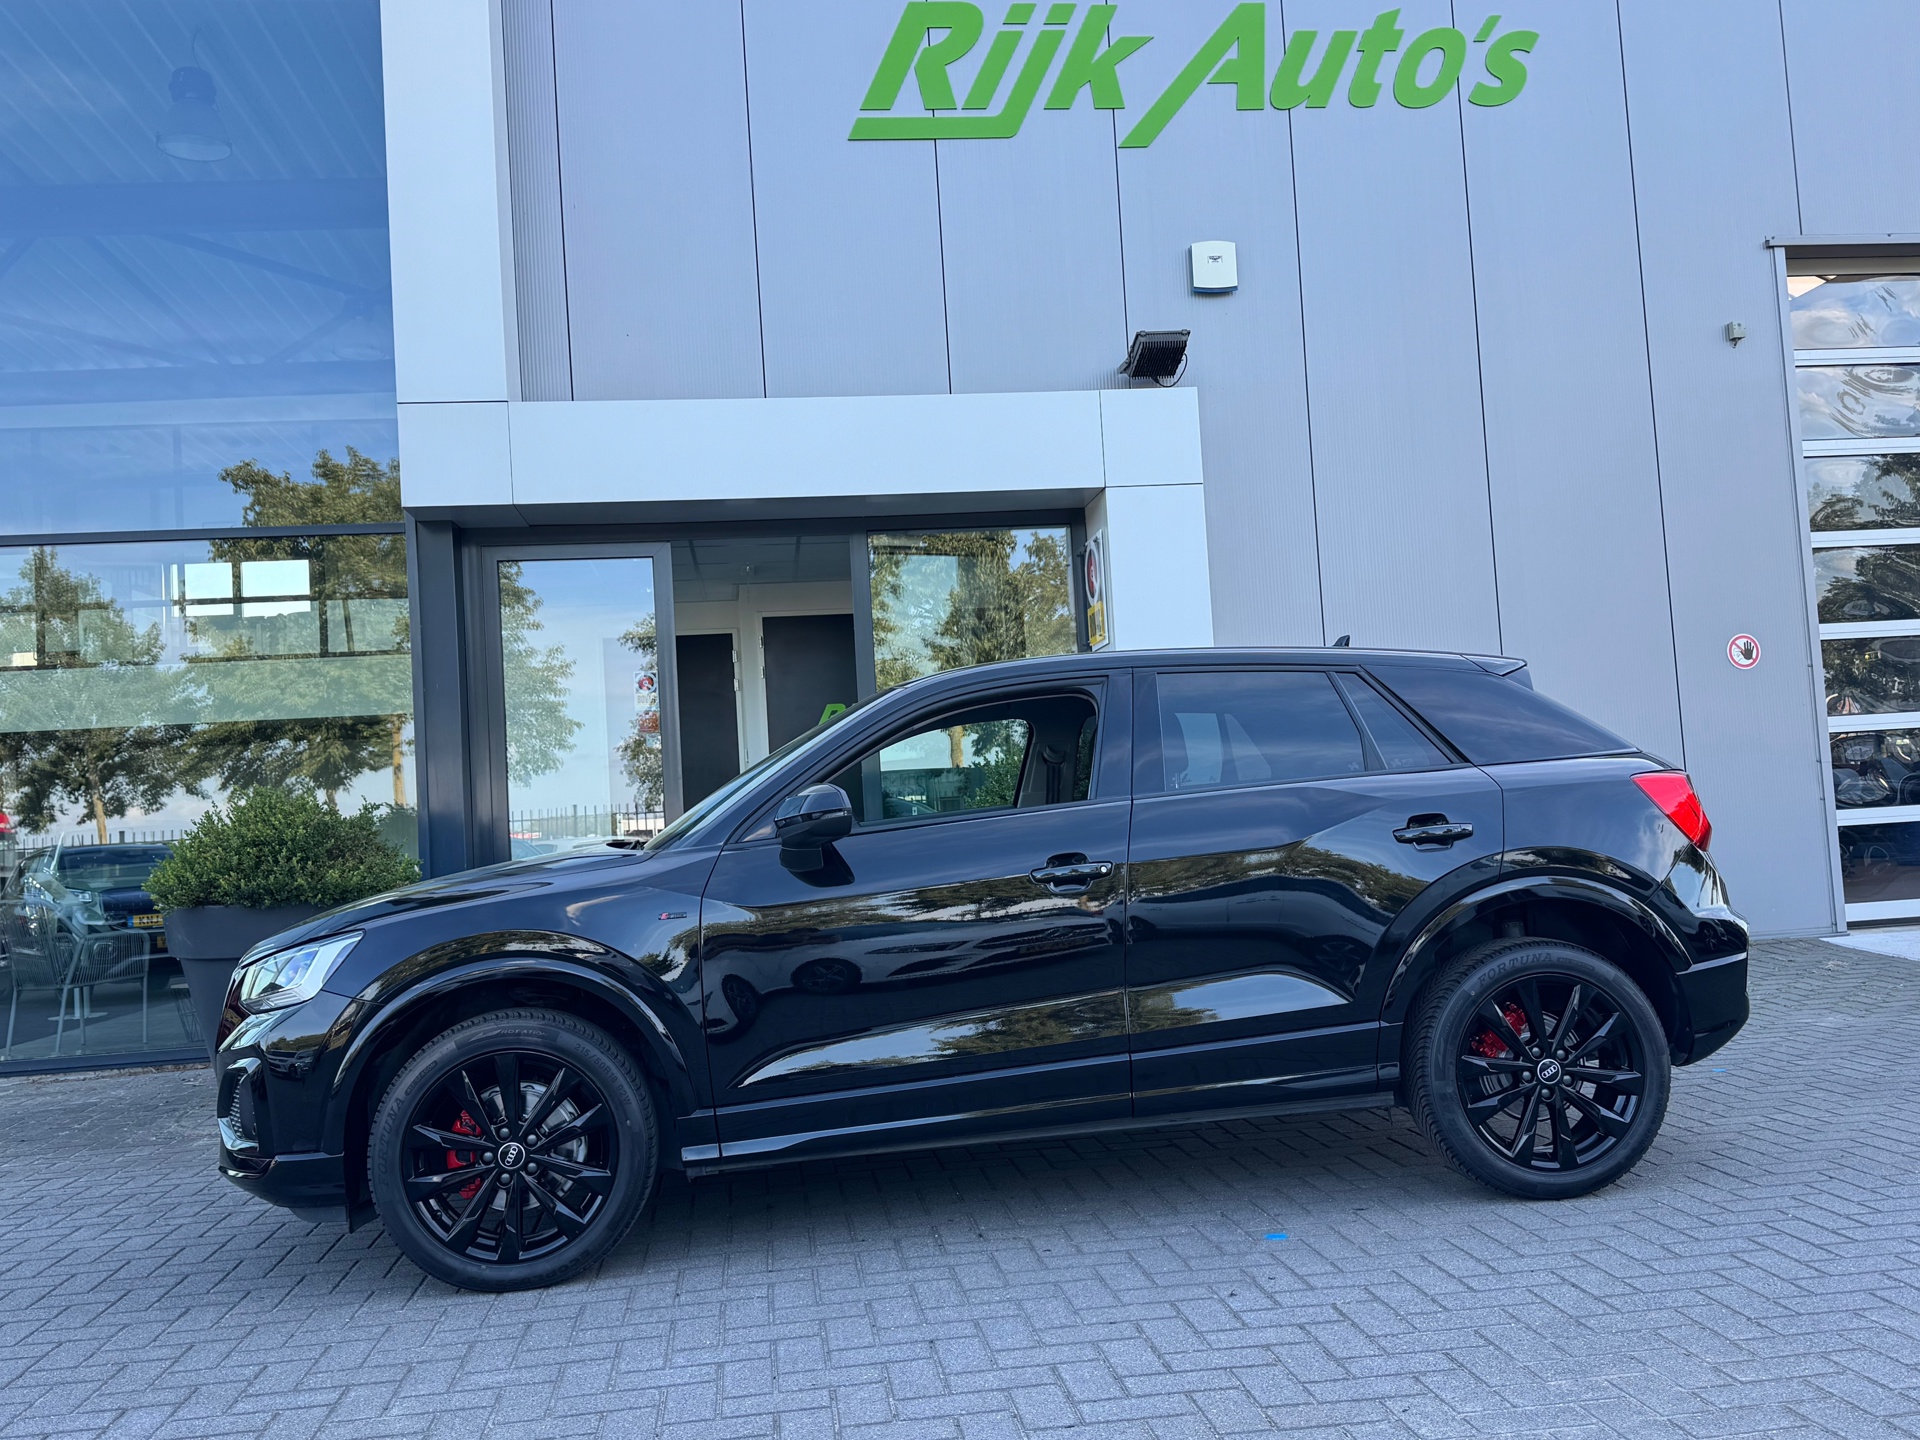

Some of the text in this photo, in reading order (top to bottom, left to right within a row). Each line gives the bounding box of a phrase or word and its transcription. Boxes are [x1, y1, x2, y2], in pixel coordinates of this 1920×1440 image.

[847, 1, 1541, 149] Rijk Auto's
[1477, 952, 1553, 988] FORTUNA
[573, 1042, 632, 1107] 215/50R18 92W
[378, 1097, 405, 1188] FORTUNA
